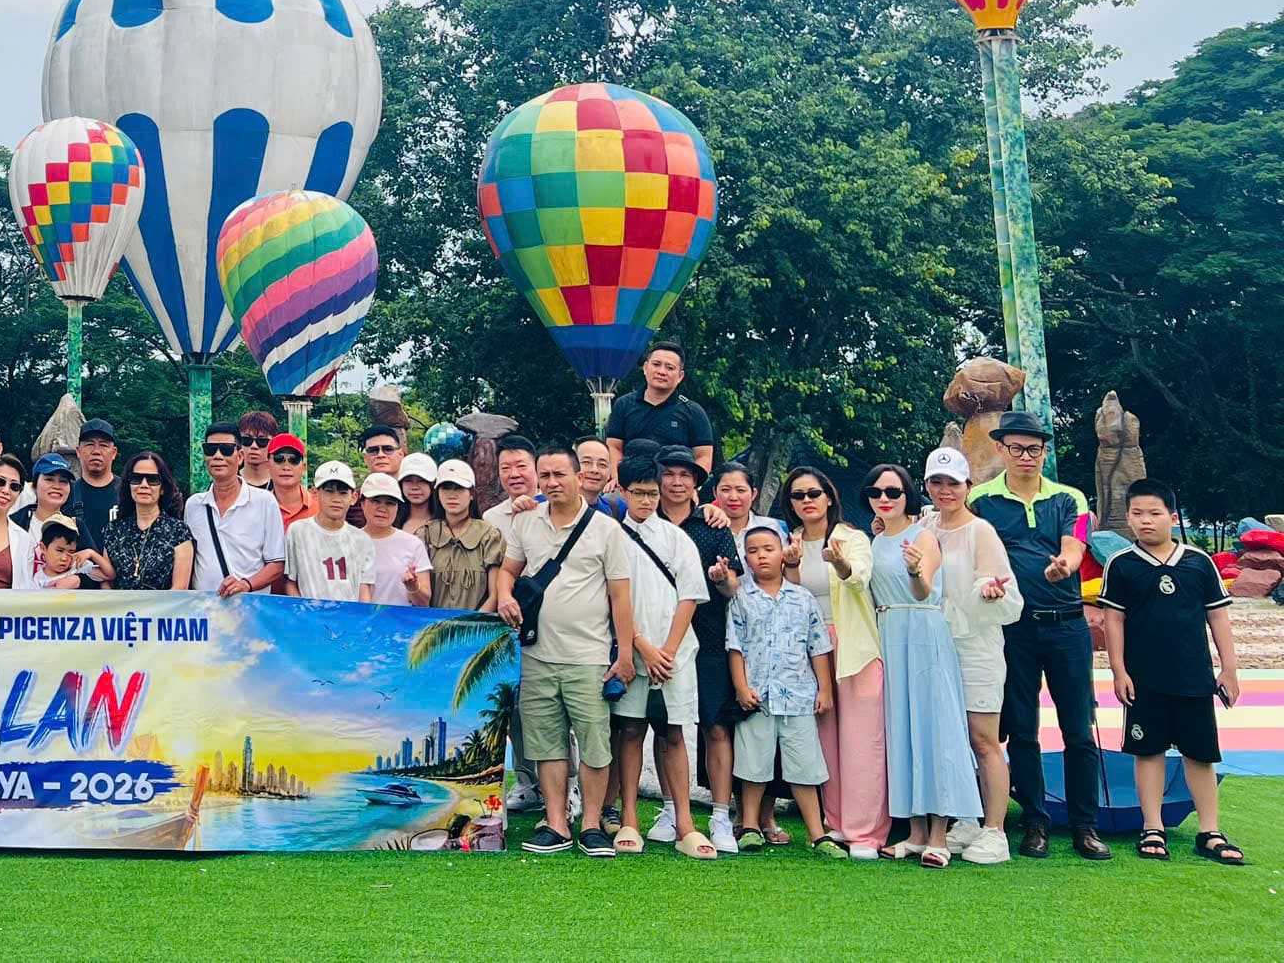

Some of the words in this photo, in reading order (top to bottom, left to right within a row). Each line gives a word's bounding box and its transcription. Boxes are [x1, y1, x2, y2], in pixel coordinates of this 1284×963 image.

[322, 556, 347, 580] 11
[100, 611, 153, 648] VIỆT
[157, 618, 209, 642] NAM
[69, 771, 154, 802] 2026
